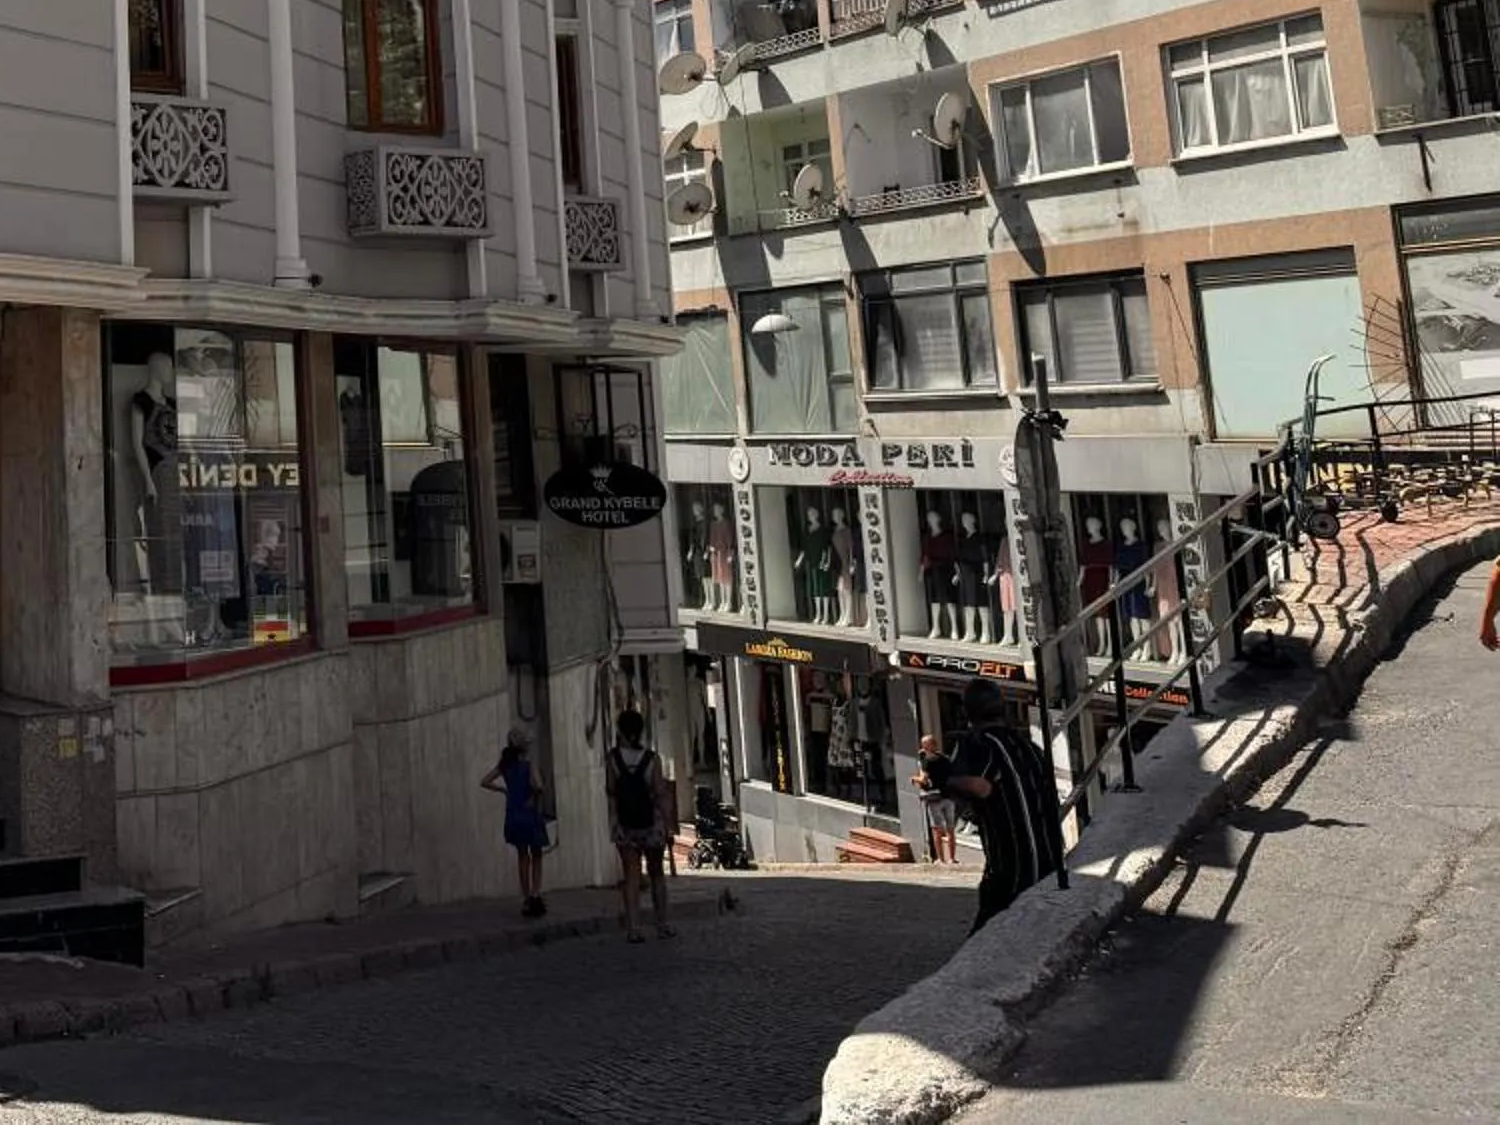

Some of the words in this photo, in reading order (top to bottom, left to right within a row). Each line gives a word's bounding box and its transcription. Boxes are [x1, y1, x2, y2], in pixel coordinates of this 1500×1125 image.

[767, 441, 866, 468] MODA
[550, 496, 602, 509] GRAND
[603, 496, 661, 510] KYBELE
[581, 510, 629, 523] HOTEL
